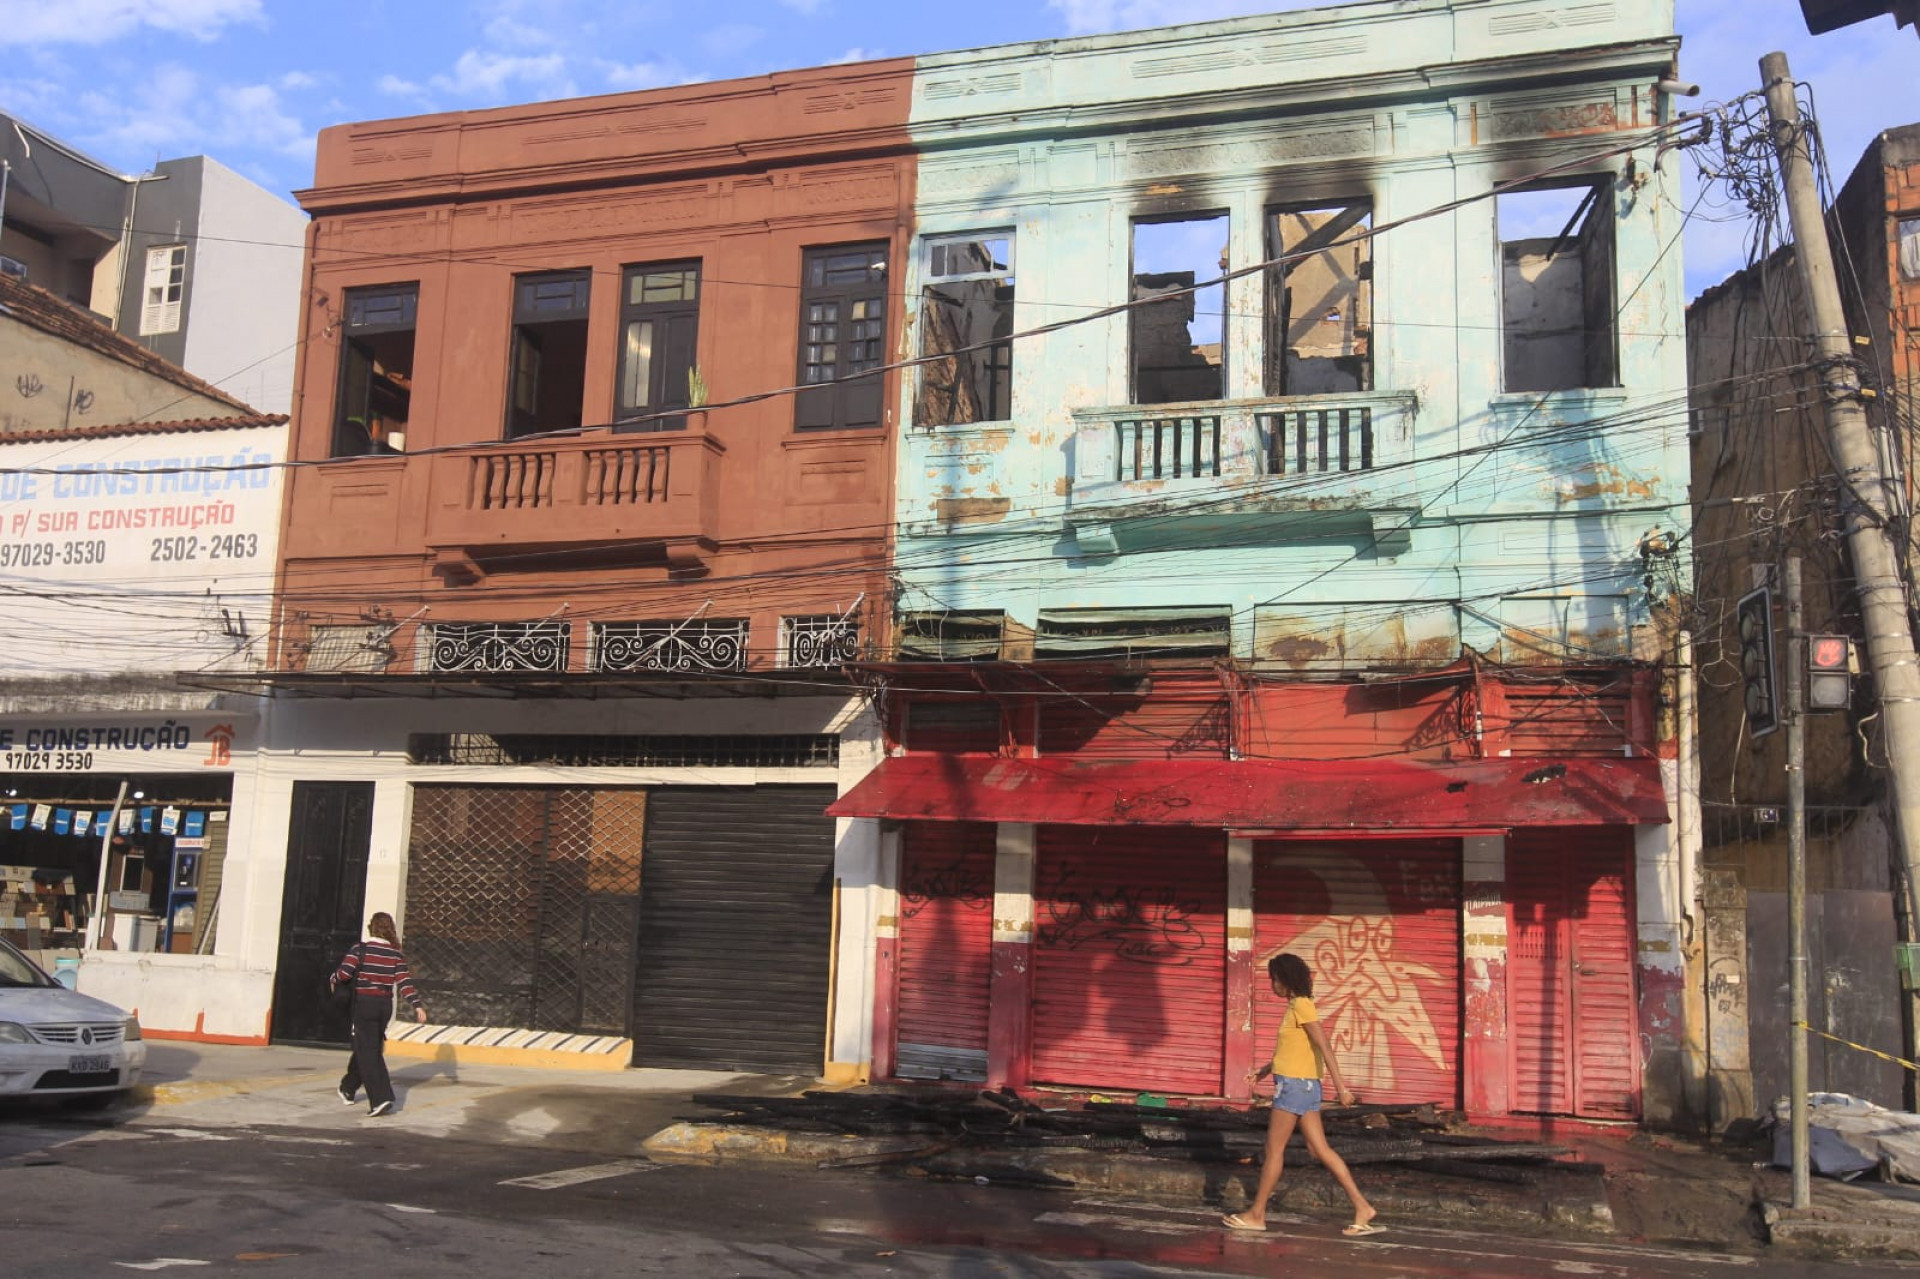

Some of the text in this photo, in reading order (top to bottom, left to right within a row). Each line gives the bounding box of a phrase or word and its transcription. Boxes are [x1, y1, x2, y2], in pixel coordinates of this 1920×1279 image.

[1, 447, 271, 500] DE CONSTRUÇÃO
[37, 511, 78, 533] SUA
[88, 500, 235, 531] CONSTRUÇÃO
[1, 533, 258, 567] 97029-3530 2502-2463
[6, 752, 92, 769] 97029 3530
